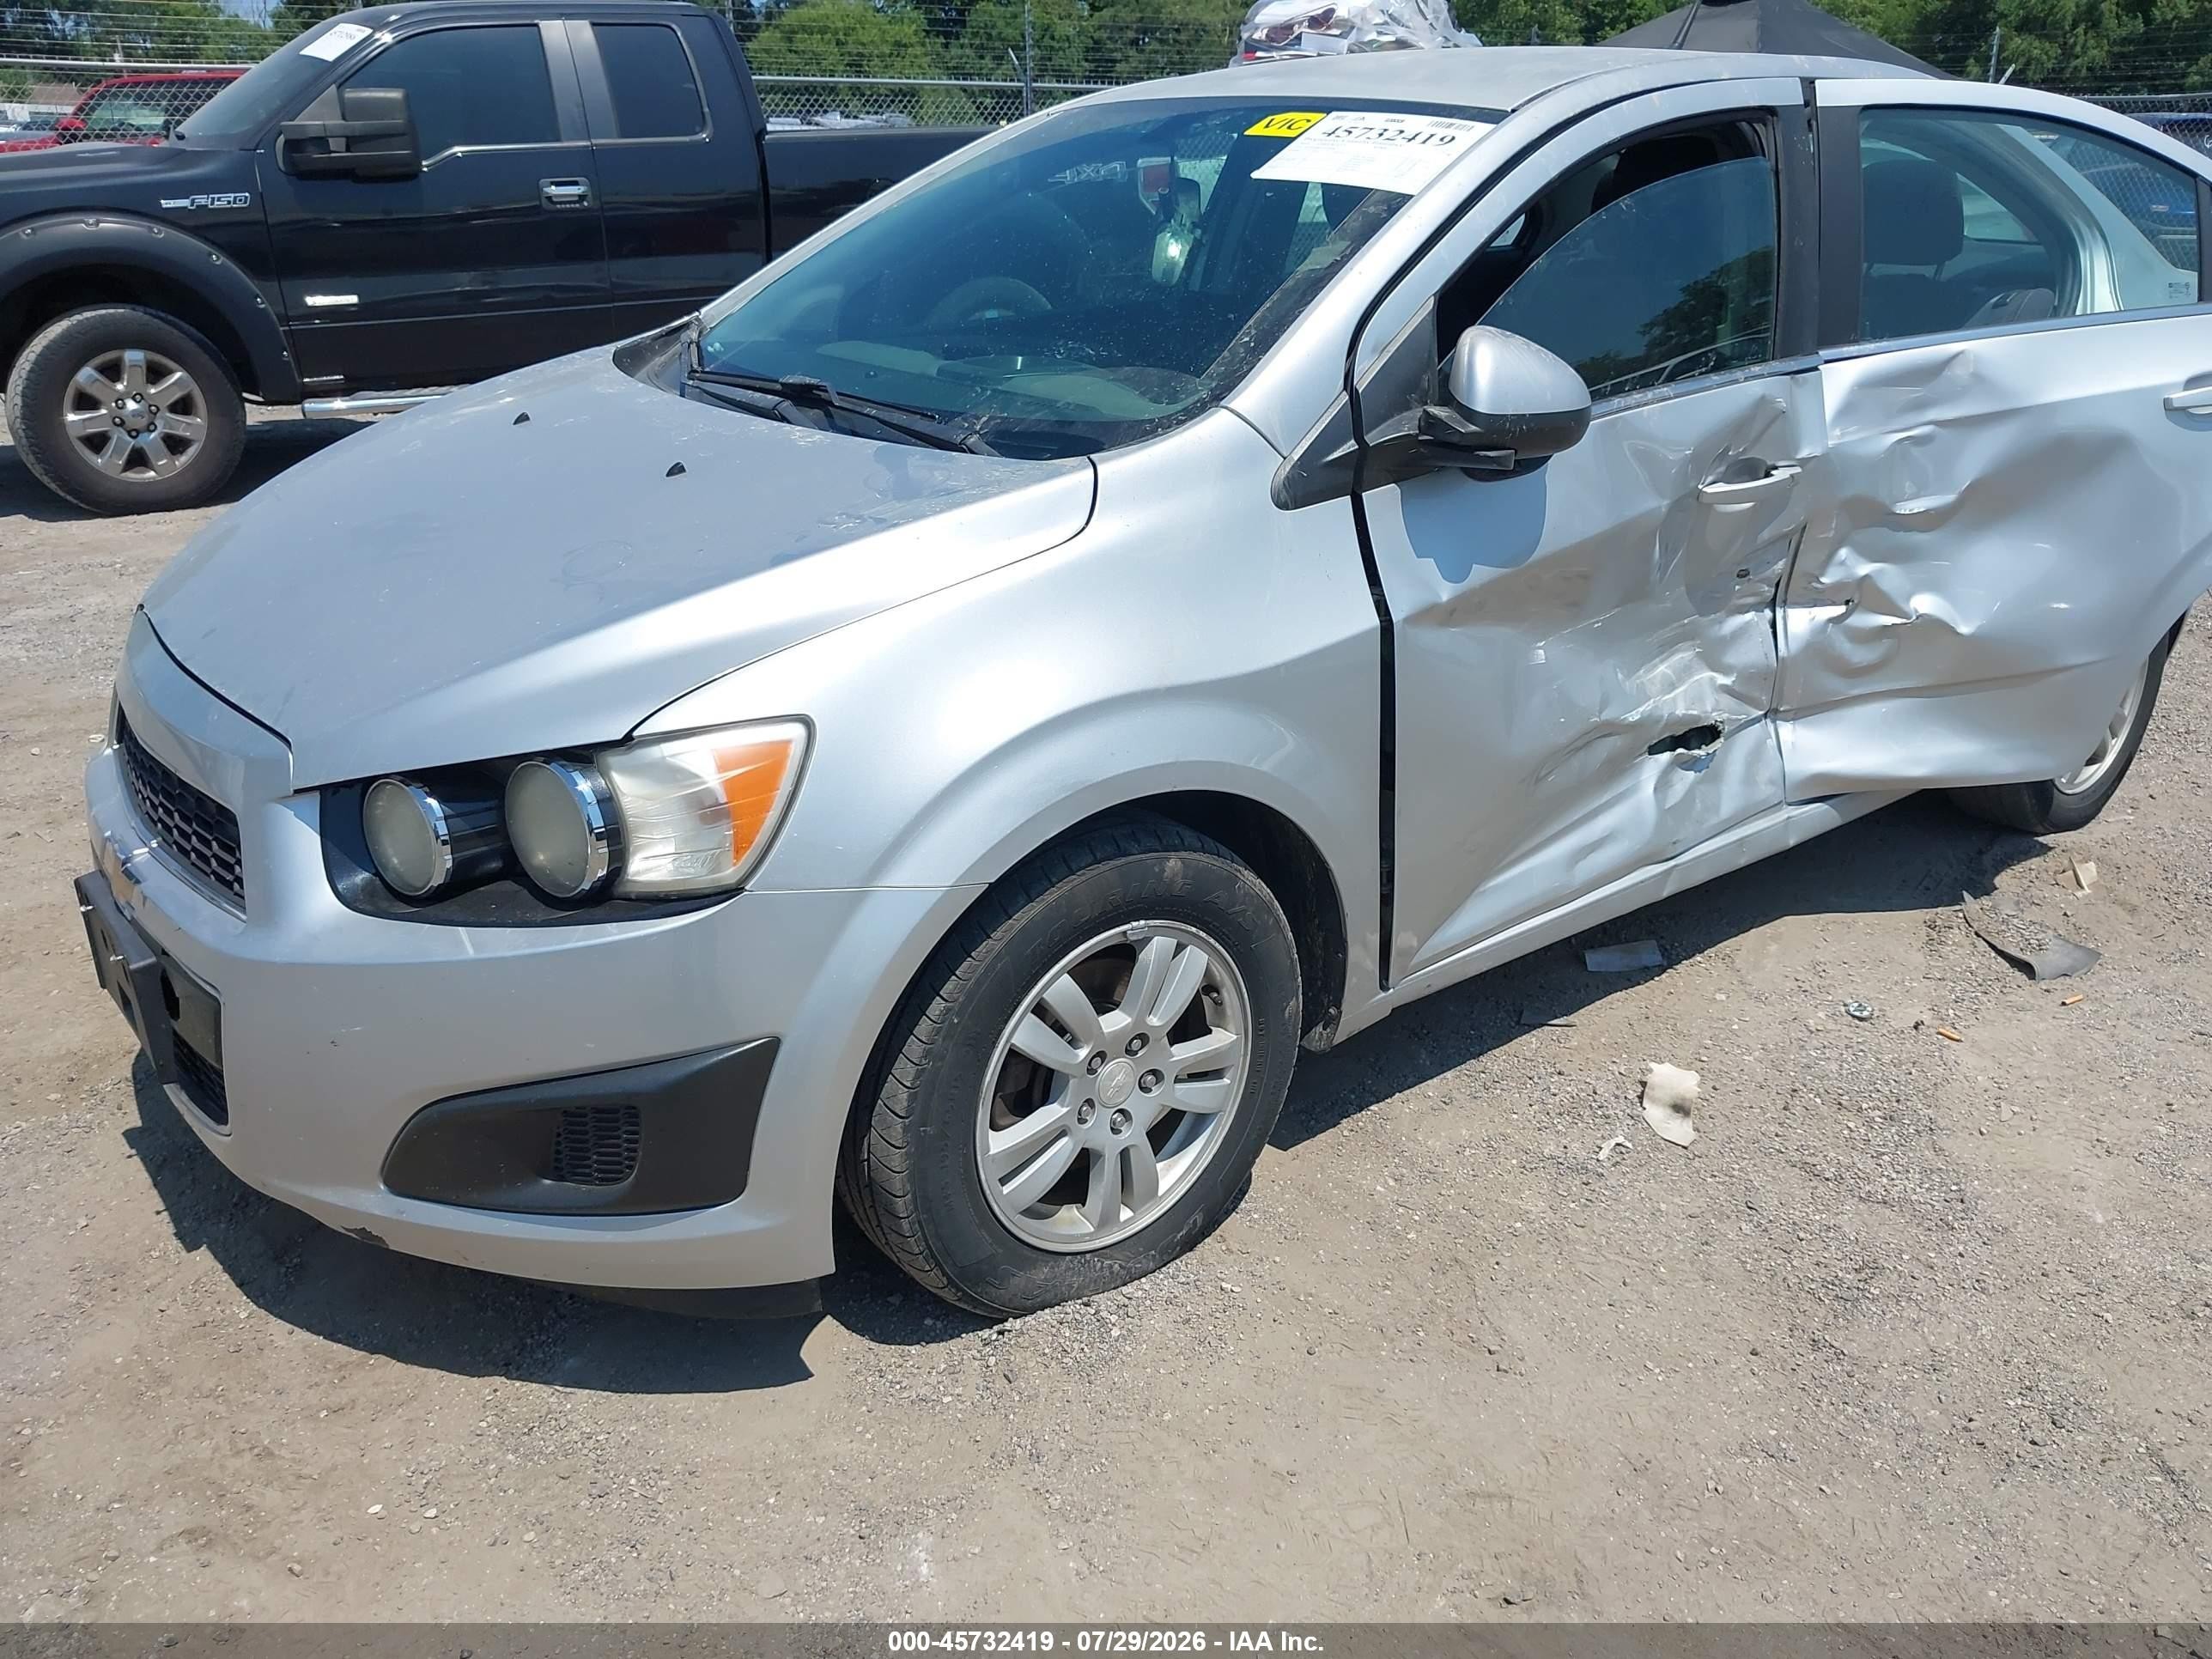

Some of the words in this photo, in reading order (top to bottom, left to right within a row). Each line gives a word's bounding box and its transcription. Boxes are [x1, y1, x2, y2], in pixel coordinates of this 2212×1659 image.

[1264, 118, 1312, 131] VIC
[1322, 125, 1456, 146] 45732419
[188, 192, 251, 209] F-150
